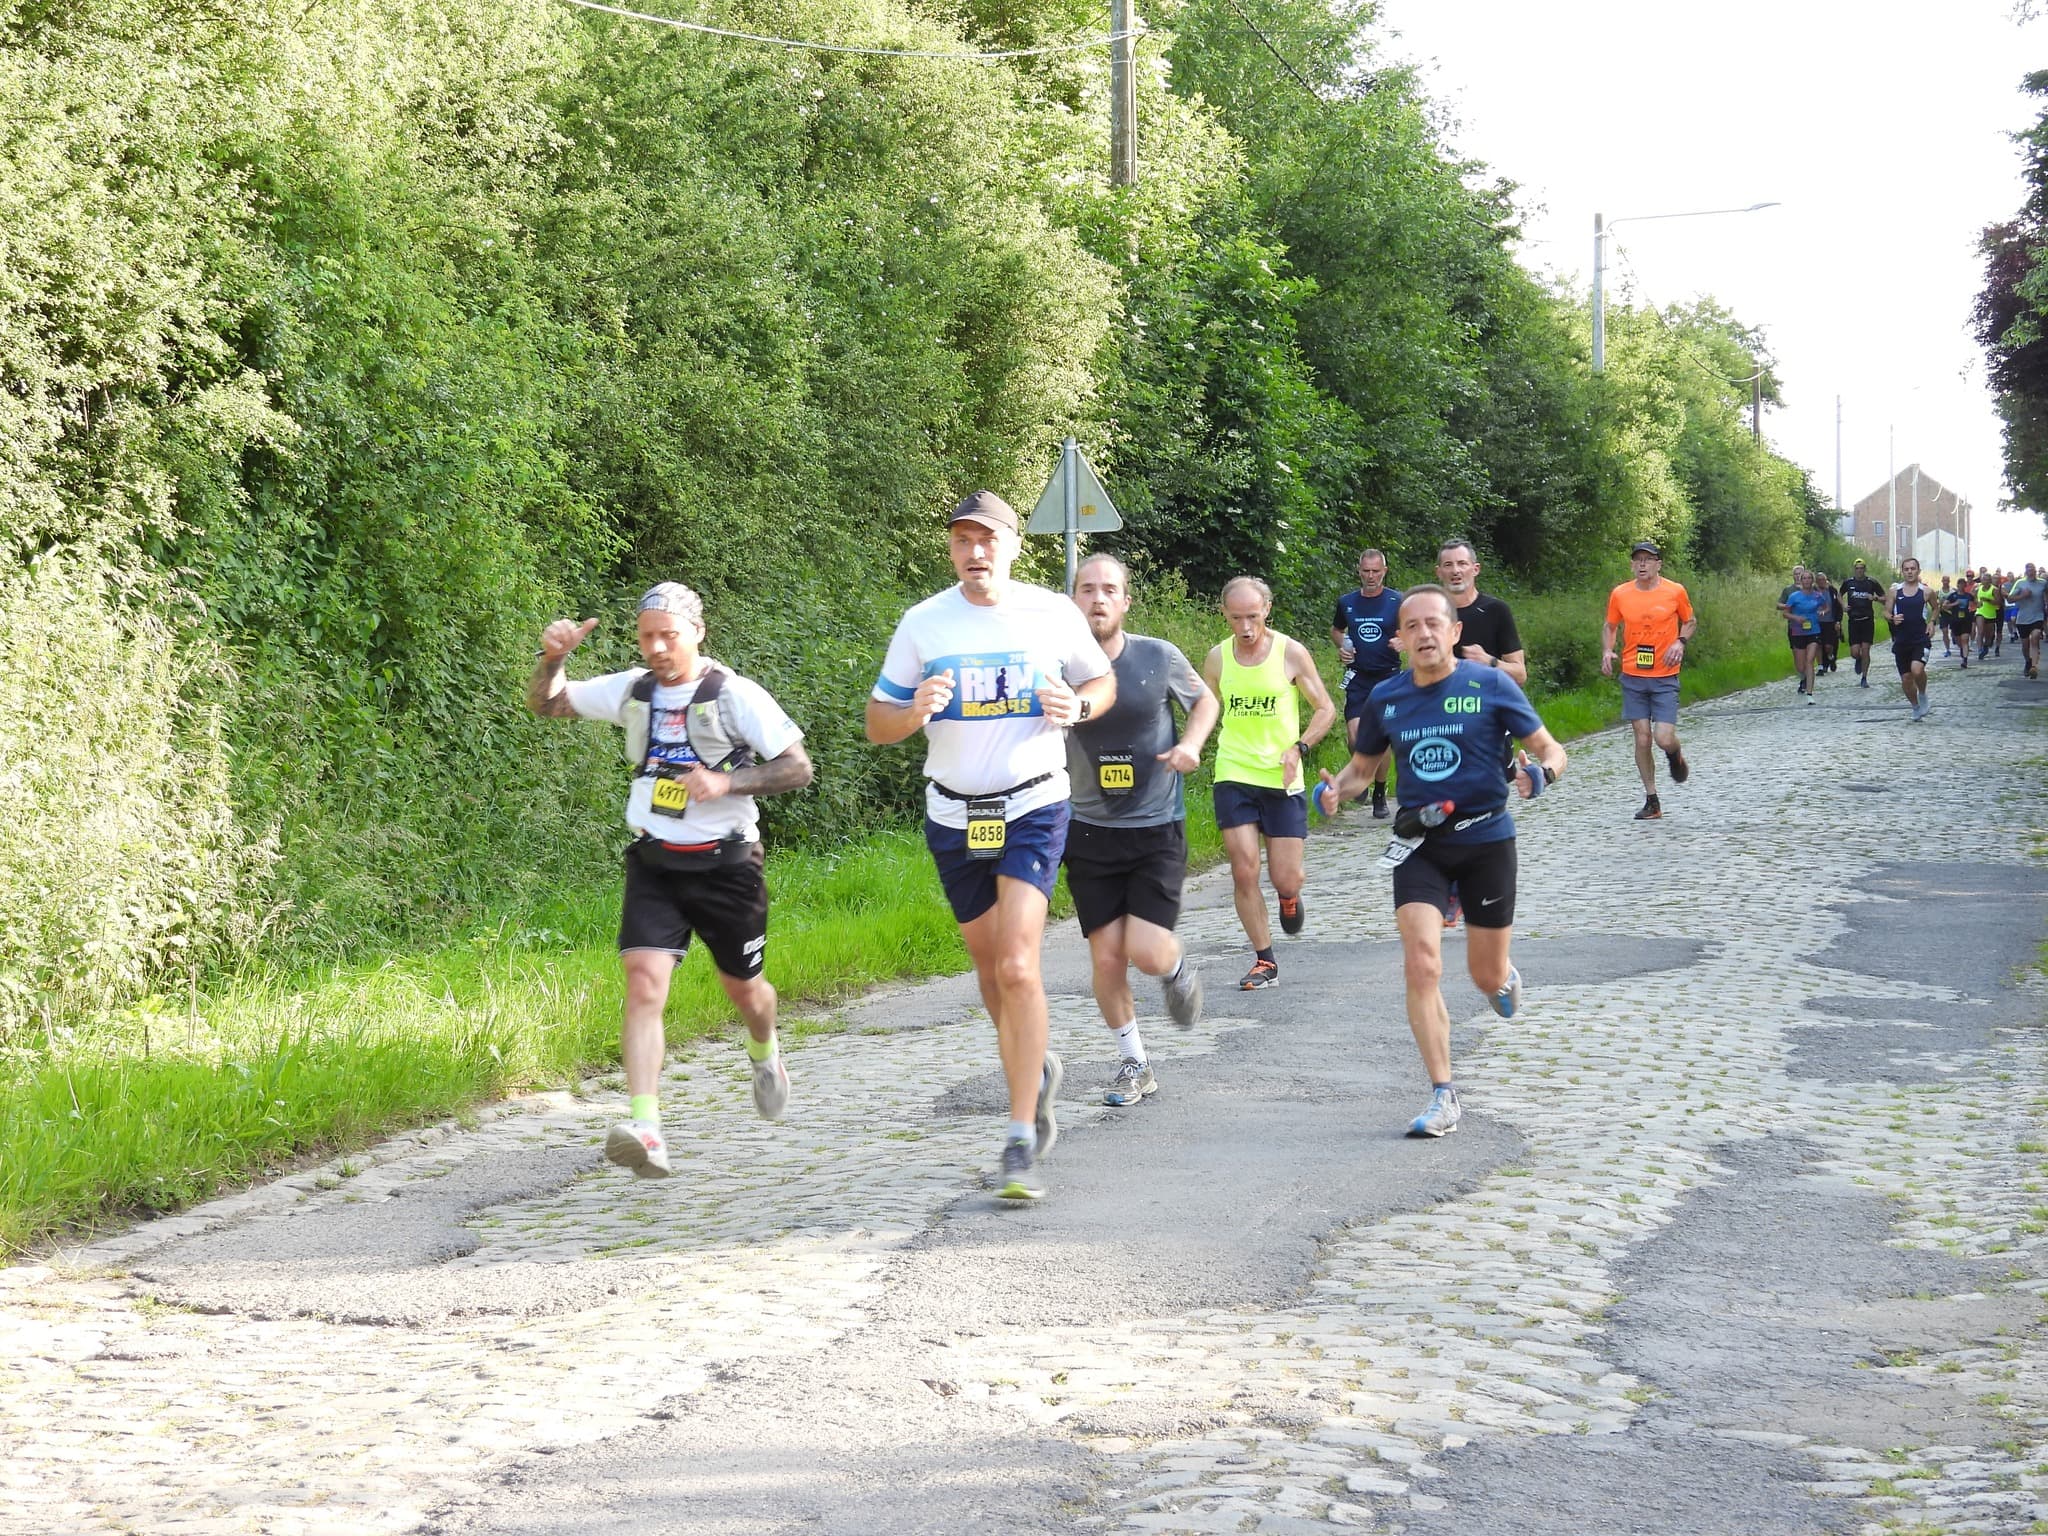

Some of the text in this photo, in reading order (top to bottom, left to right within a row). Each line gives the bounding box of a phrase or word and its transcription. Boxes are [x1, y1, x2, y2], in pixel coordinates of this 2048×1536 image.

[960, 664, 1034, 701] RUN
[1444, 697, 1481, 714] GIGI
[1104, 769, 1131, 782] 4714
[971, 826, 1003, 842] 4858
